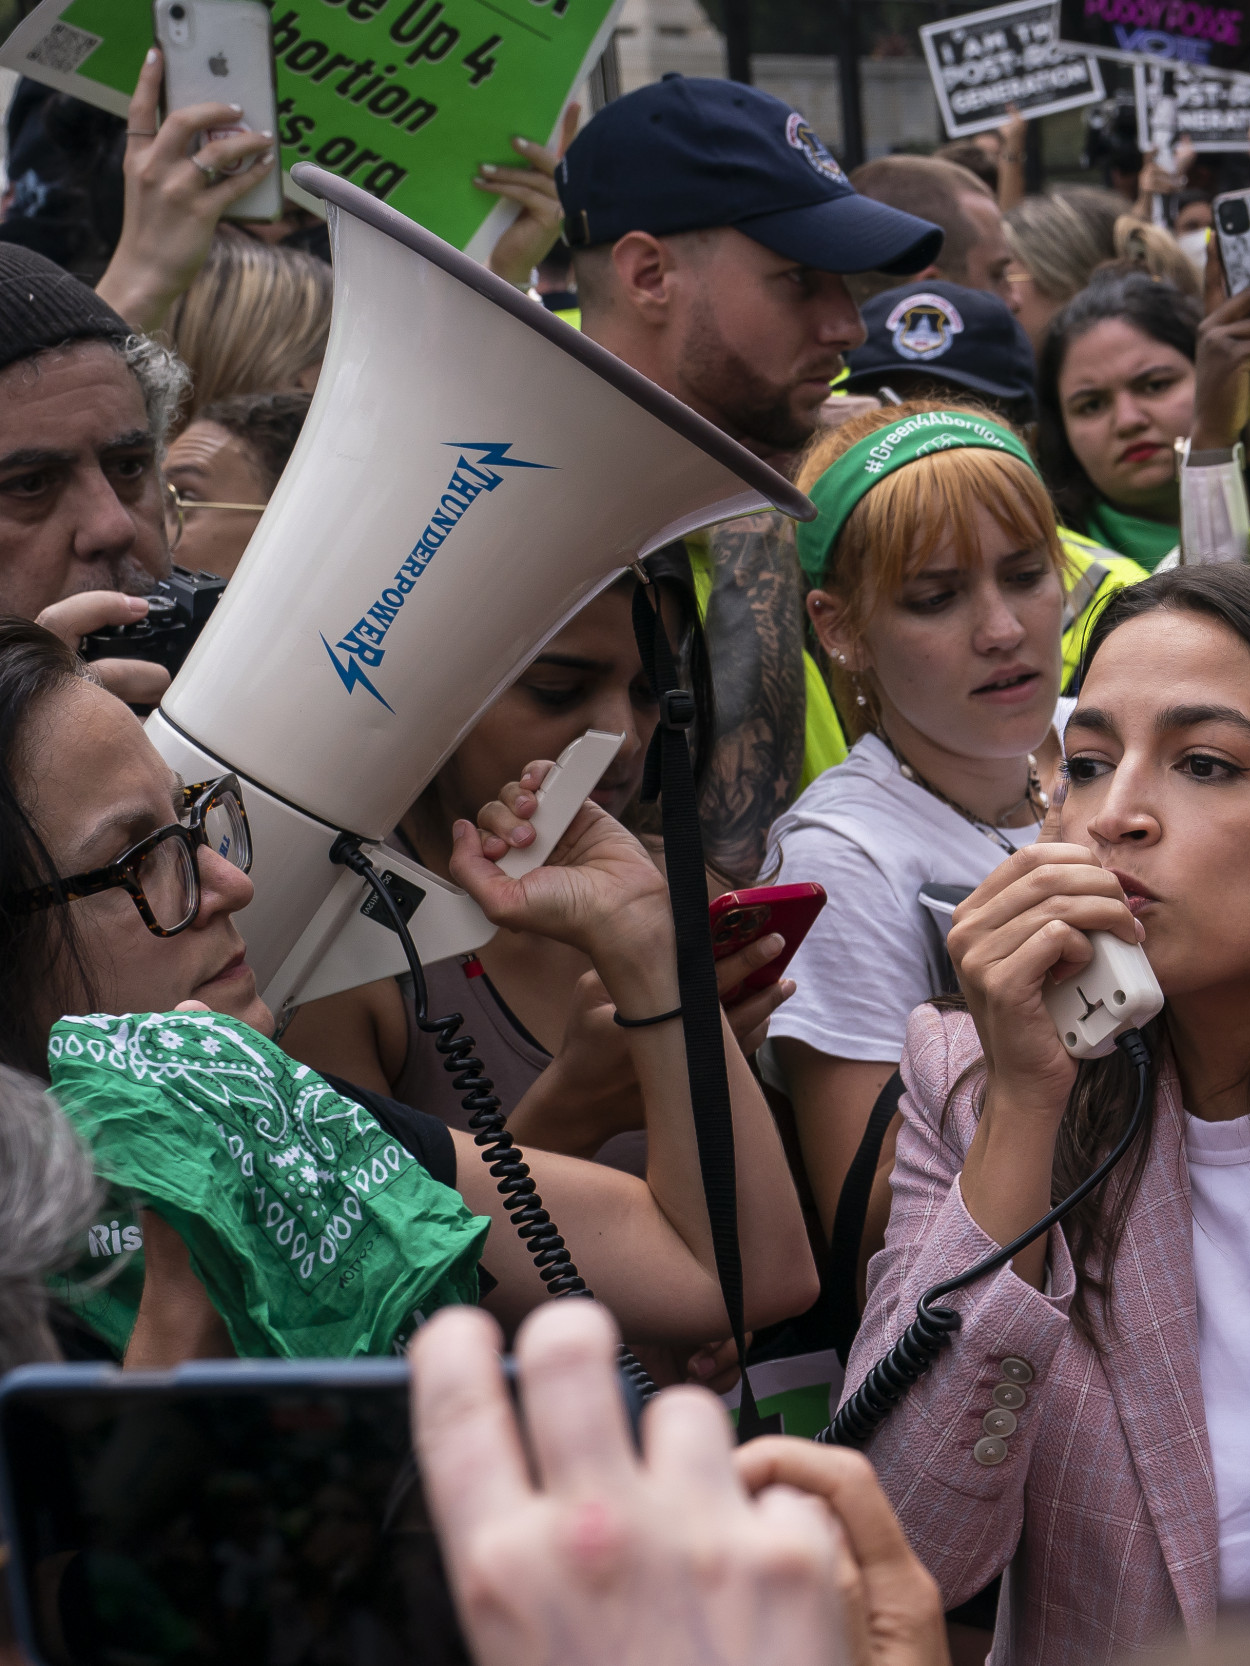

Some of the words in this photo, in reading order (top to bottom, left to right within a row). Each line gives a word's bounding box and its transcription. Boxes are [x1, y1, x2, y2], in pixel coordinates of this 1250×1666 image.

[388, 0, 461, 67] Up
[462, 34, 504, 87] 4
[942, 43, 1078, 93] POST-RO
[963, 30, 1008, 59] AM
[1112, 23, 1213, 63] VOTE
[272, 10, 438, 135] bortion
[951, 59, 1090, 115] GENERATION
[864, 412, 1006, 475] #Green4Abortion
[382, 874, 393, 885] DC
